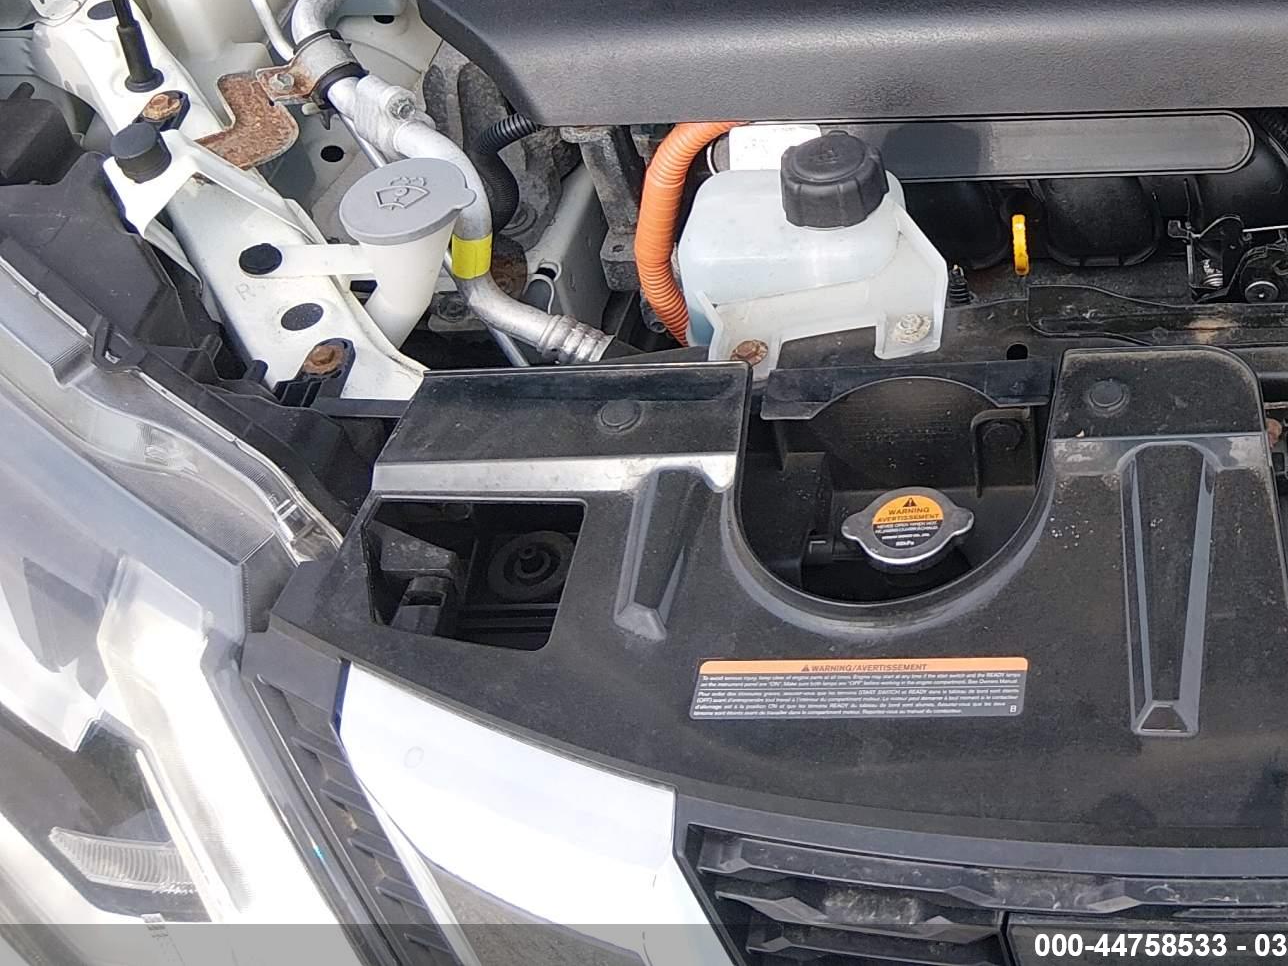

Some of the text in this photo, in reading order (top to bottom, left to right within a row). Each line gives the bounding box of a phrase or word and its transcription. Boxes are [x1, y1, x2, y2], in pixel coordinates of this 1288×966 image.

[888, 507, 930, 515] WARNING
[876, 513, 940, 522] AVERTISSEMENT
[811, 664, 928, 673] WARNING/AVERTISSEMENT
